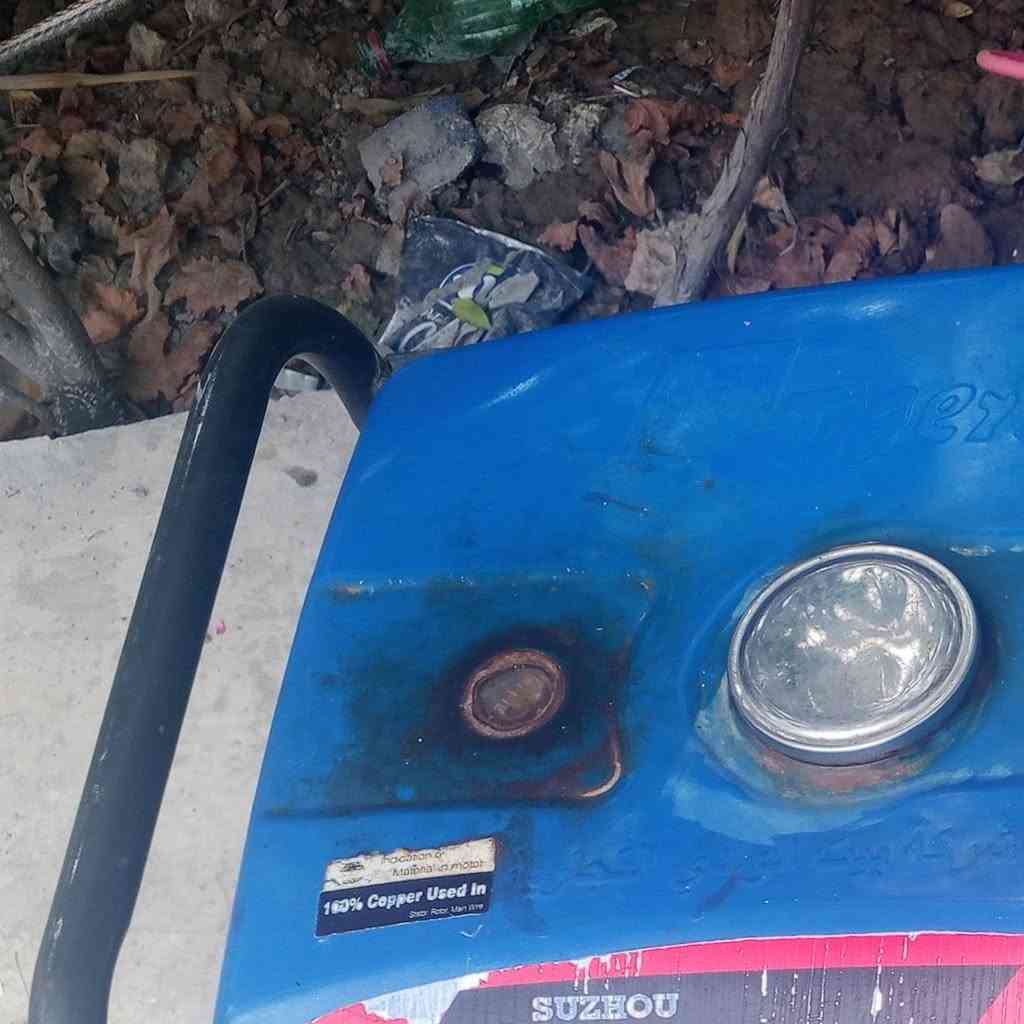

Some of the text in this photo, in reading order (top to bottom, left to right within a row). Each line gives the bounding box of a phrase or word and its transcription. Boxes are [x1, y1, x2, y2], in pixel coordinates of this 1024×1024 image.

[367, 891, 423, 910] Copper
[426, 883, 467, 901] Used
[470, 882, 487, 896] In
[531, 992, 681, 1022] SUZHOU
